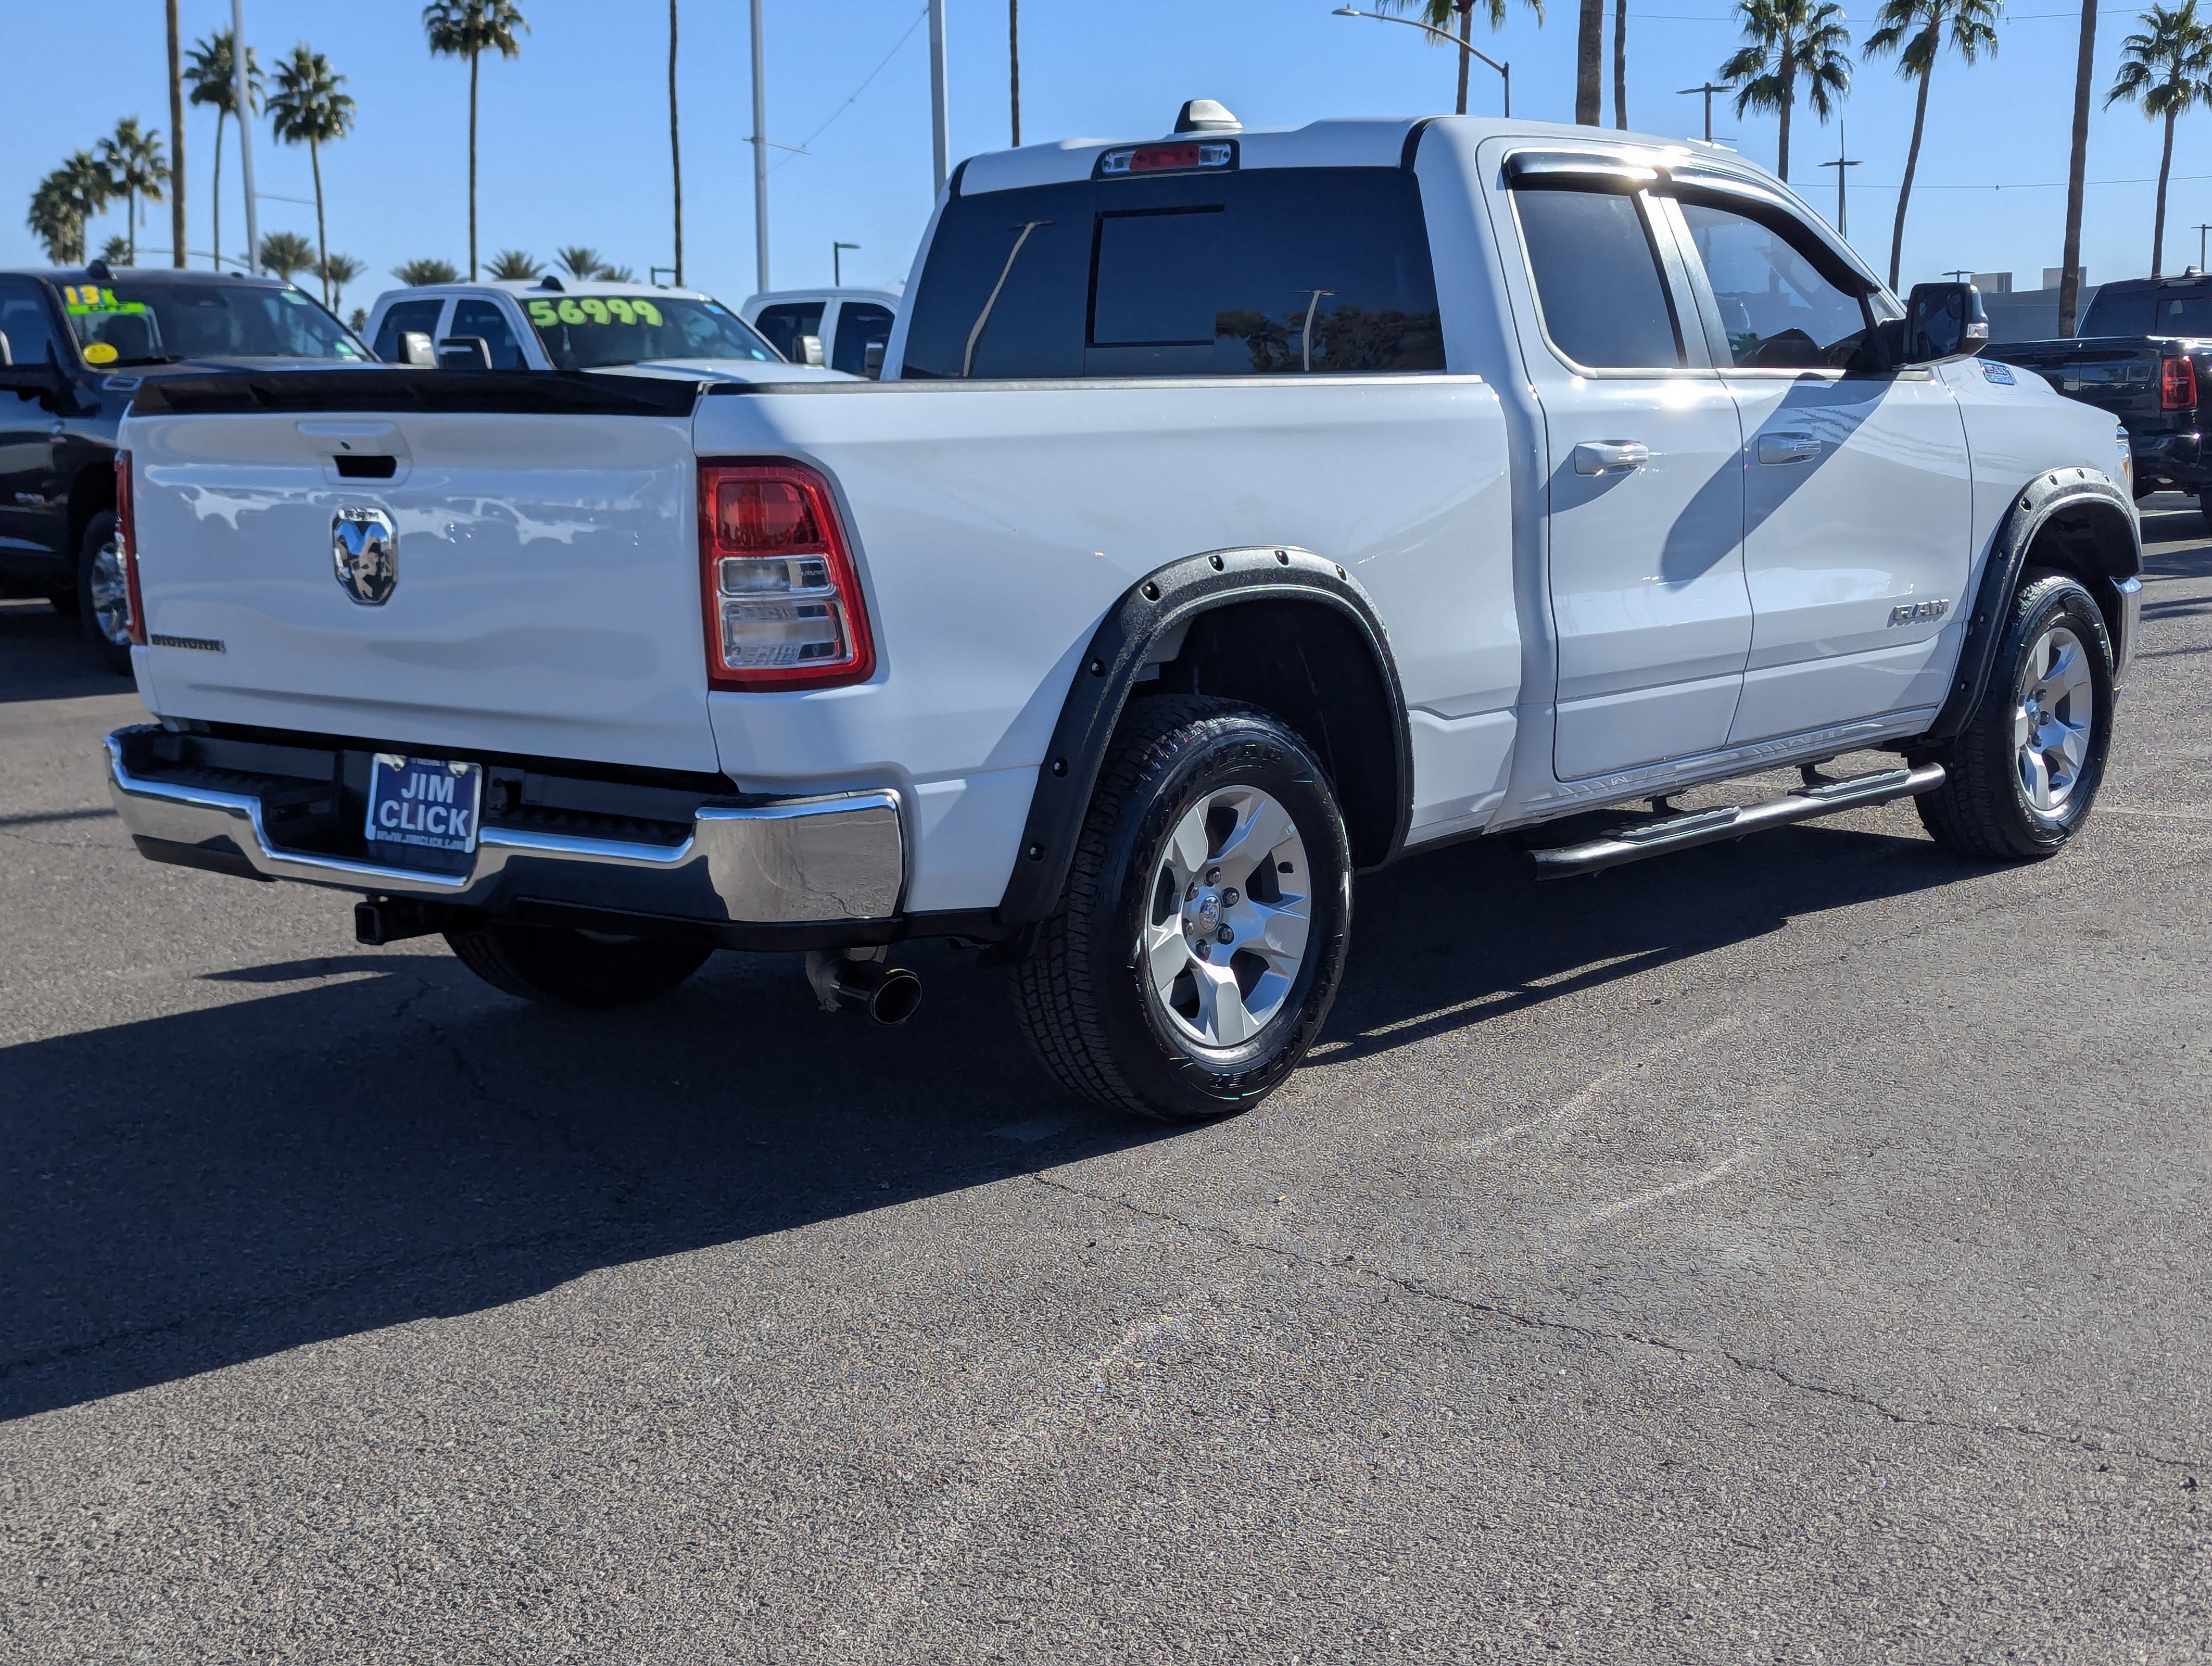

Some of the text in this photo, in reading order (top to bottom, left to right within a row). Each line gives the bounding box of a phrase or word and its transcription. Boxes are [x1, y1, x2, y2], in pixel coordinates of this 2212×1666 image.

[529, 299, 663, 326] 56999
[1894, 599, 1950, 620] RAM
[401, 772, 455, 804] JIM
[380, 800, 470, 837] CLICK
